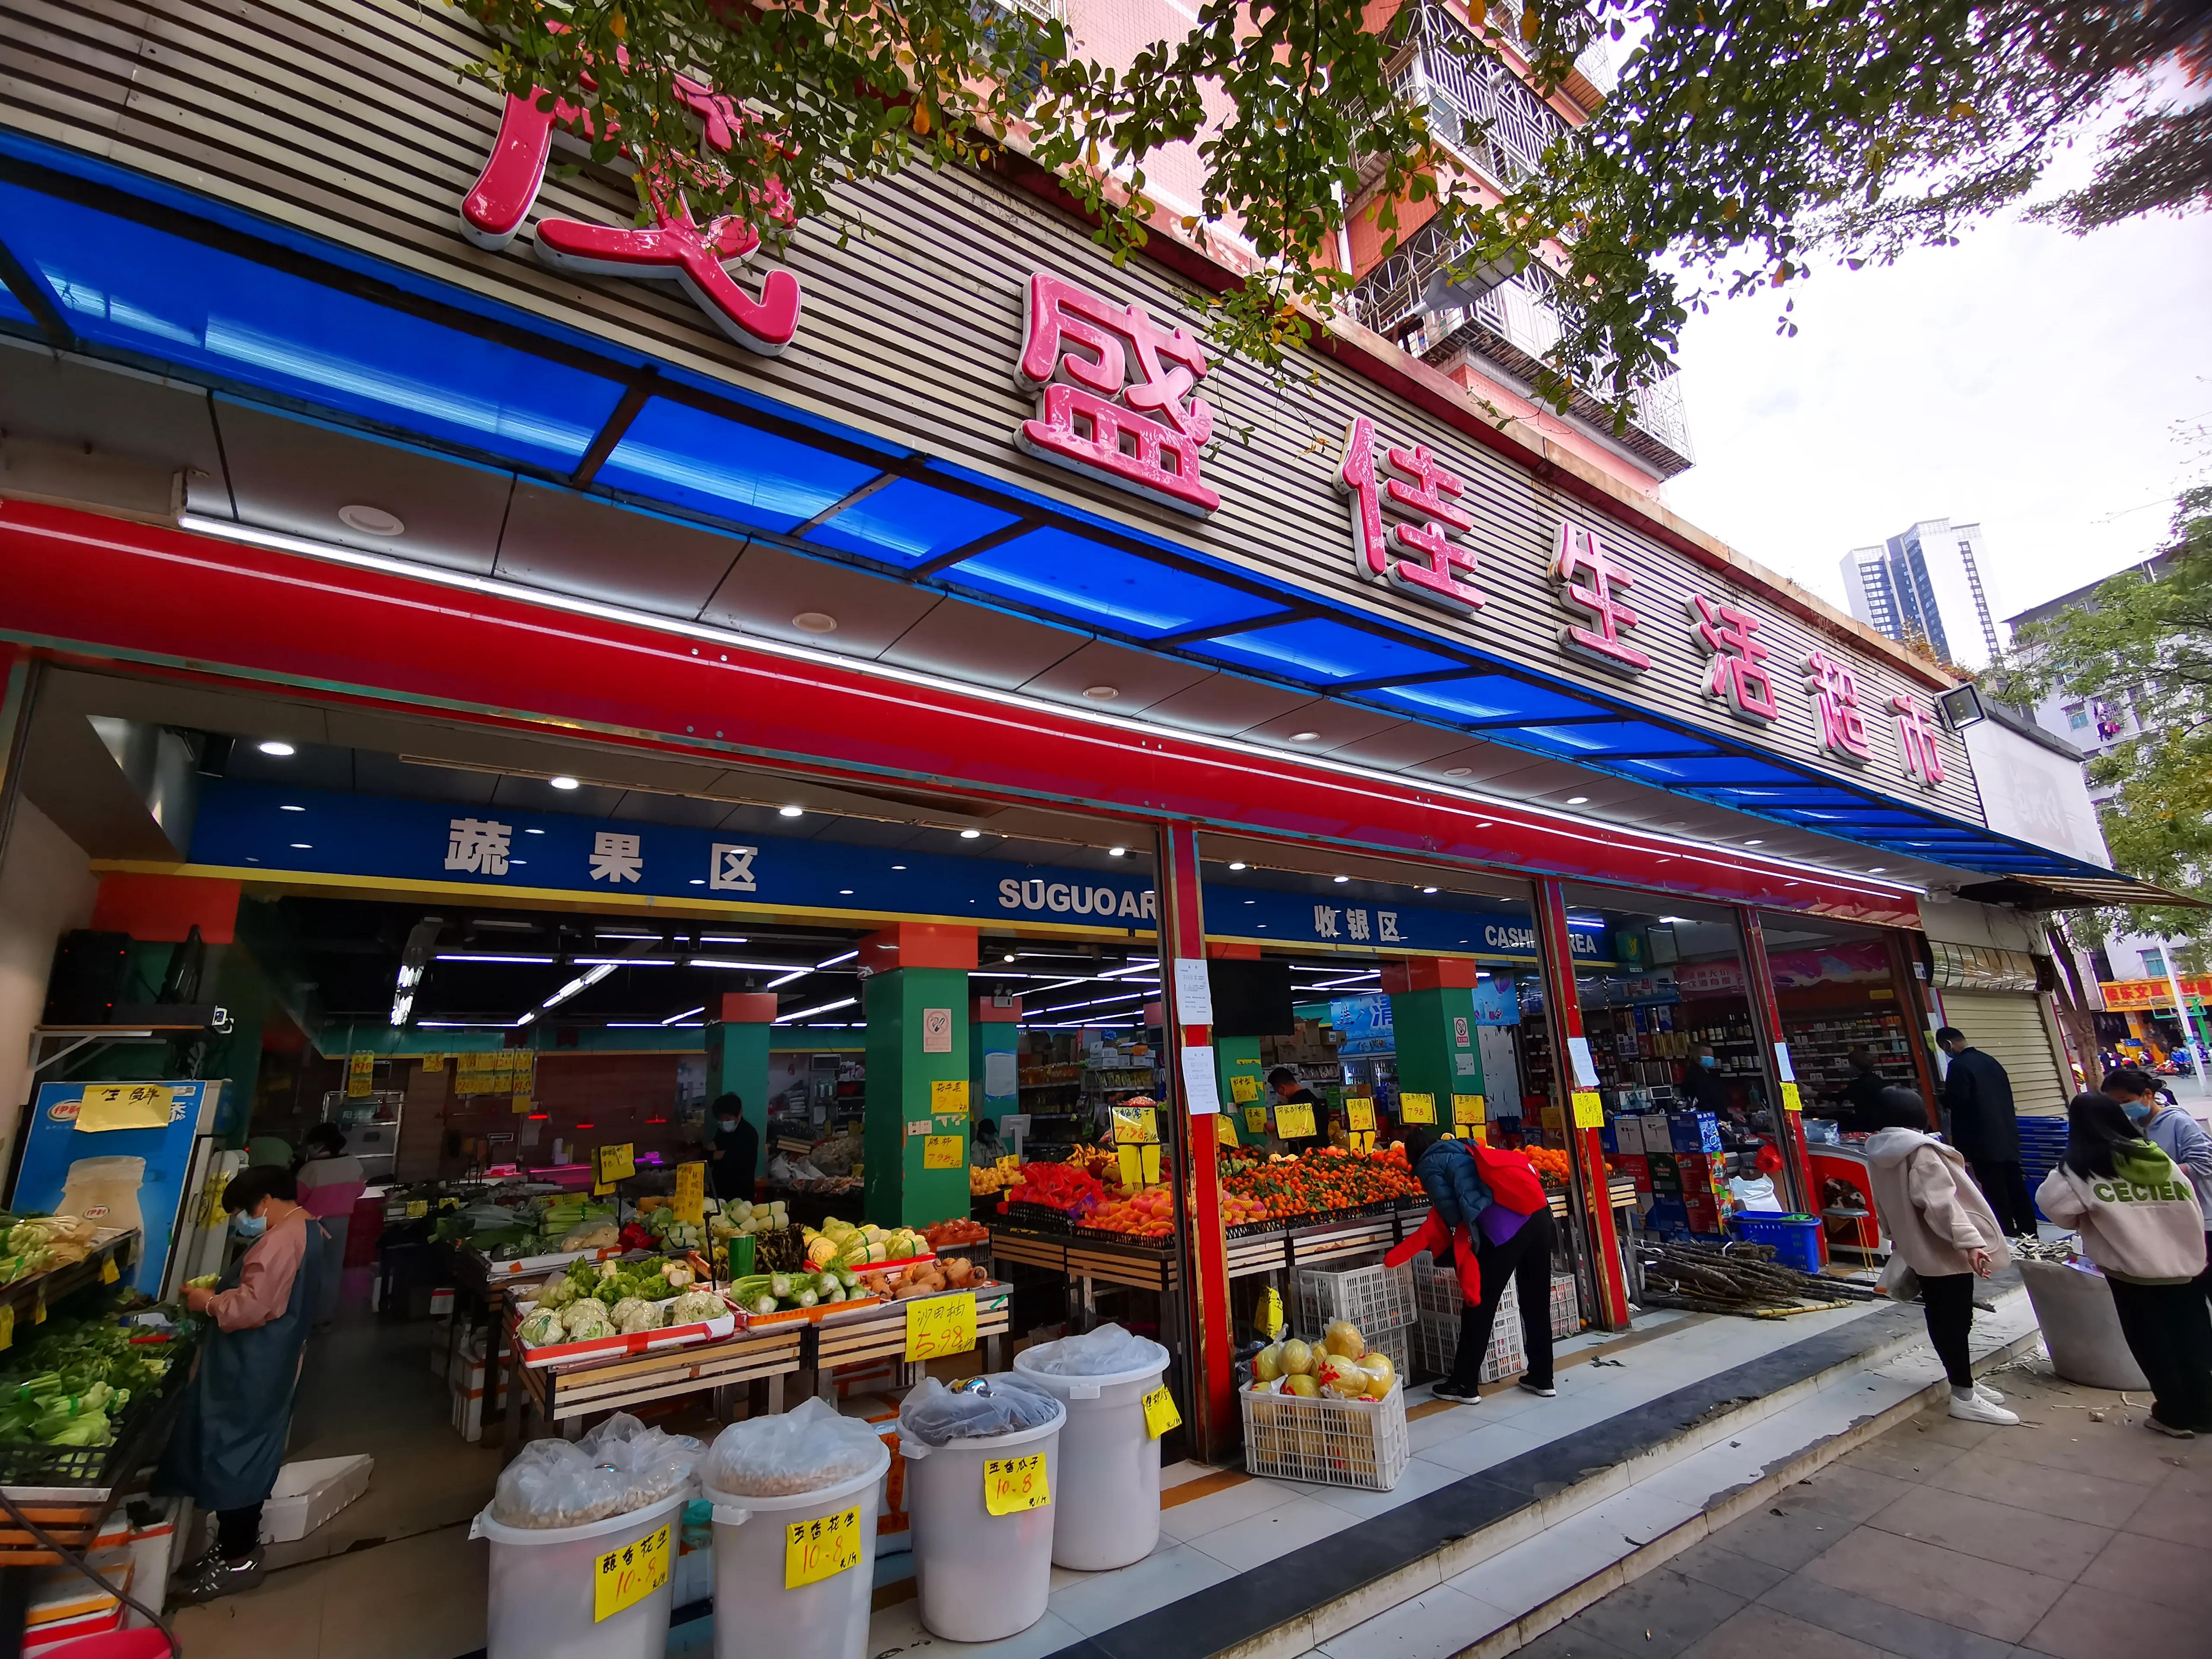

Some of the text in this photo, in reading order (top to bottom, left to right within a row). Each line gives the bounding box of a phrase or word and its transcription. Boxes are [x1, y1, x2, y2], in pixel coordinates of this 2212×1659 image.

[445, 818, 758, 892] 蔬果区
[1314, 905, 1400, 941] 收银区
[915, 1325, 963, 1358] 5.98
[988, 1456, 1038, 1475] 五香瓜子
[997, 1473, 1032, 1500] 10.8
[794, 1511, 855, 1545] 五香花生
[803, 1535, 843, 1574] 10.8
[615, 1556, 656, 1602] 10.8
